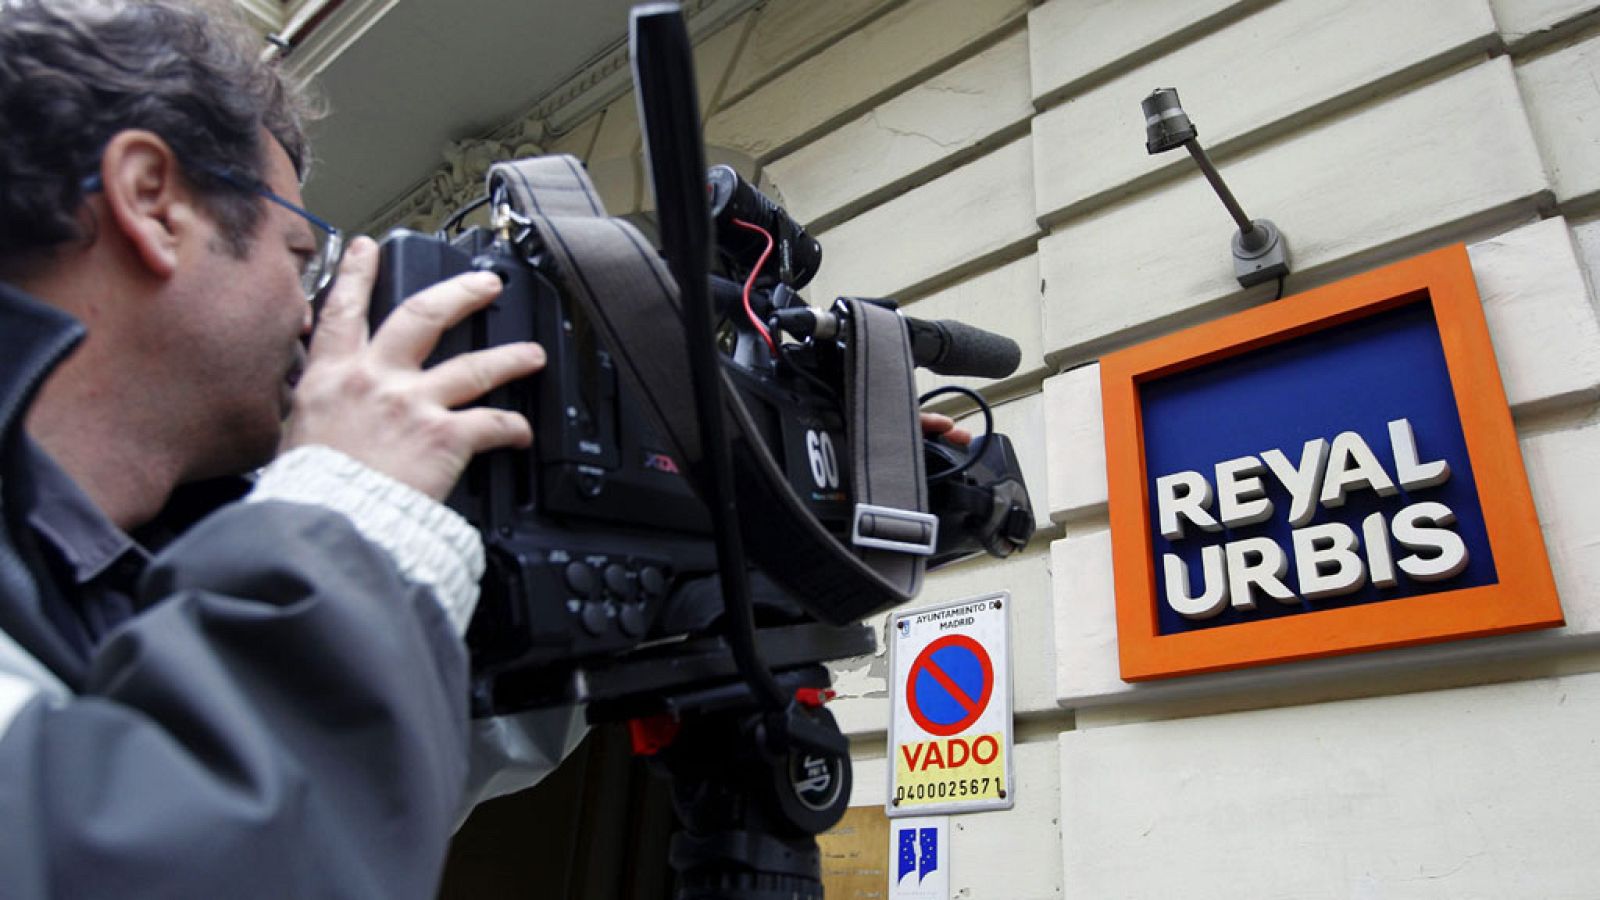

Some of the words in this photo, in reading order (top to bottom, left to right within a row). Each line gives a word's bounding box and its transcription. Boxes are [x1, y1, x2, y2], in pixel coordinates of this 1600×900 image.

[807, 429, 839, 489] 60
[1156, 418, 1449, 540] REYAL
[1163, 501, 1469, 621] URBIS
[916, 602, 986, 624] AYUNTAMIENTO
[939, 616, 975, 630] MADRID
[901, 735, 999, 772] VADO
[897, 777, 1001, 801] 0400025671
